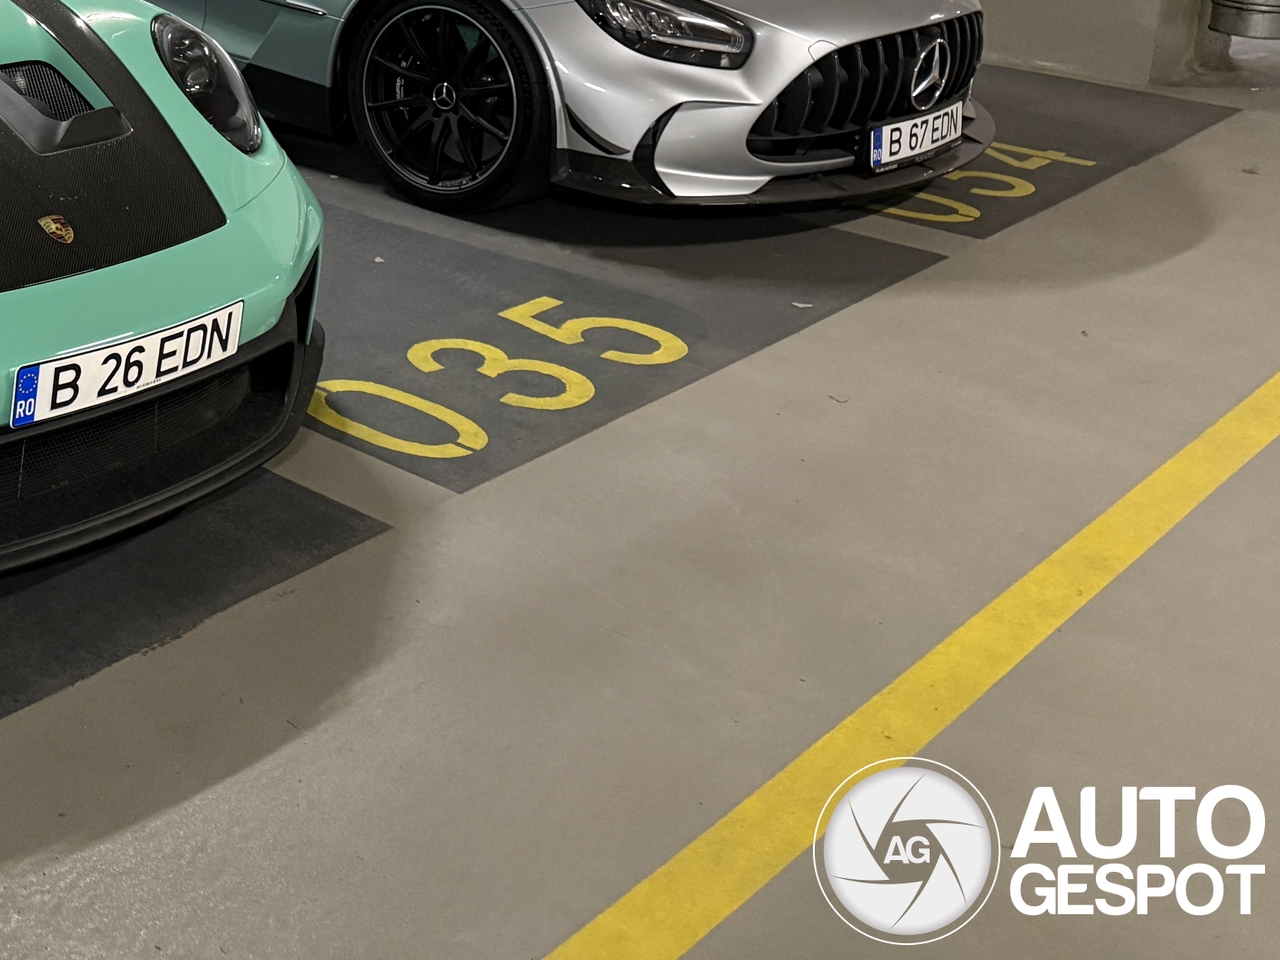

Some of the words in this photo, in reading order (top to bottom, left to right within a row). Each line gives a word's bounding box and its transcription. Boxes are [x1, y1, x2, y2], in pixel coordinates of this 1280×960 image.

[873, 149, 882, 161] RO
[889, 126, 902, 157] B
[908, 119, 929, 152] 67
[931, 105, 959, 145] EDN
[50, 363, 82, 411] B
[96, 345, 146, 398] 26
[155, 311, 233, 379] EDN
[306, 296, 689, 459] 035
[15, 397, 35, 419] RO
